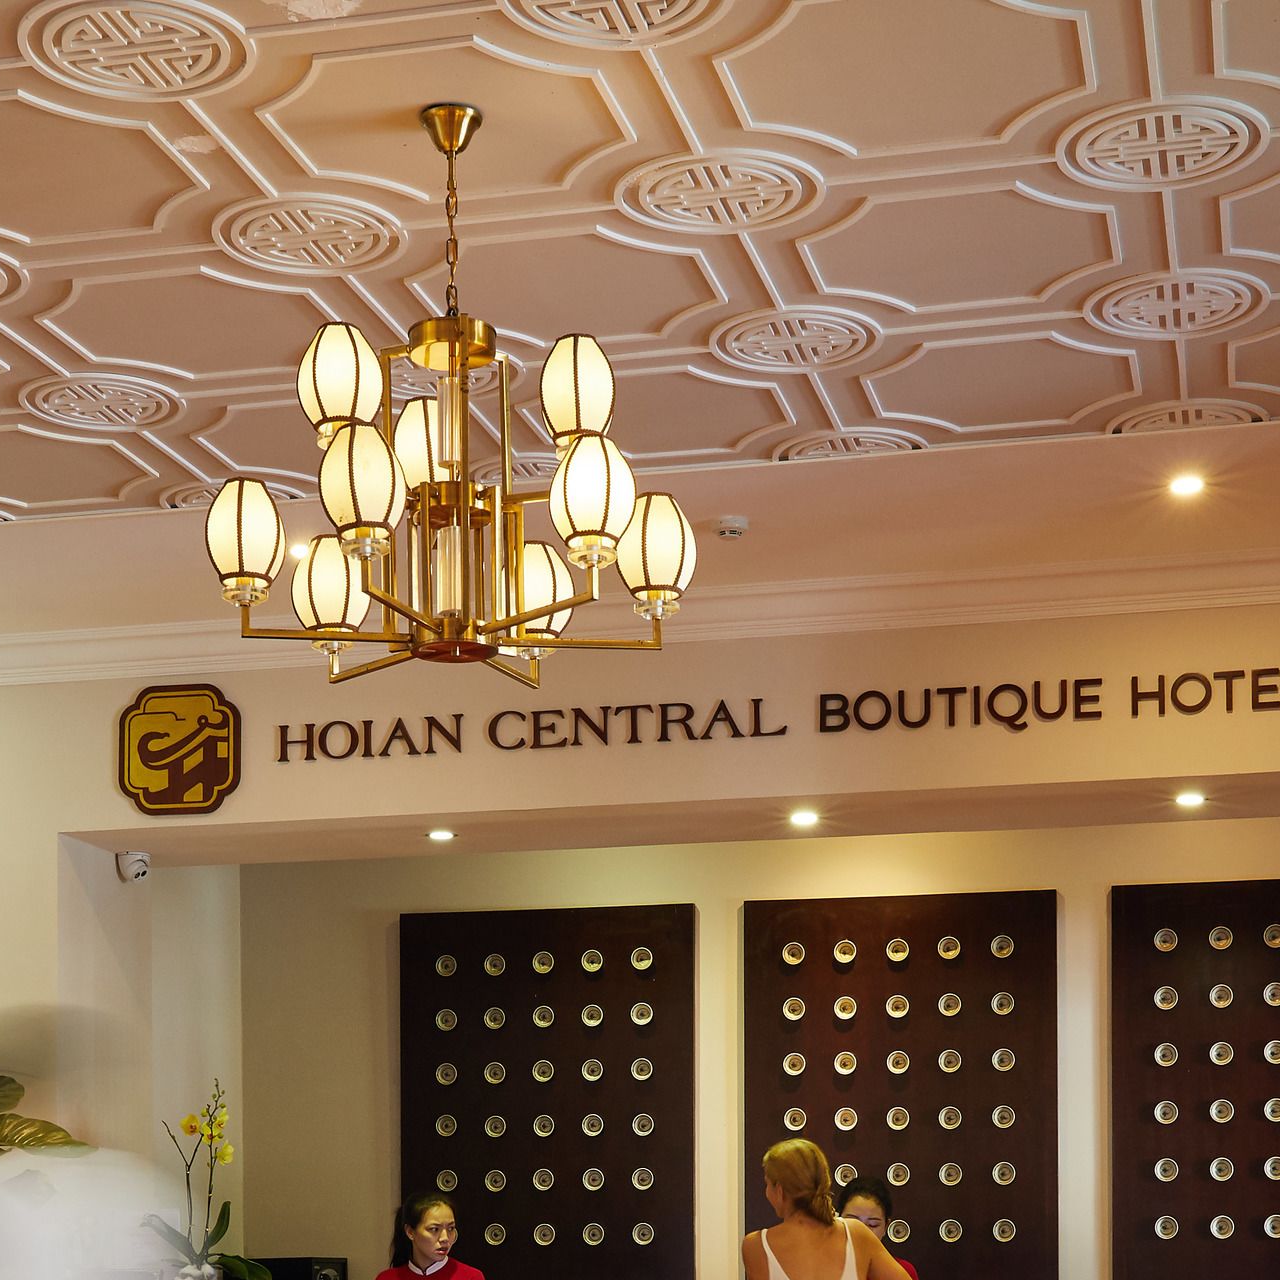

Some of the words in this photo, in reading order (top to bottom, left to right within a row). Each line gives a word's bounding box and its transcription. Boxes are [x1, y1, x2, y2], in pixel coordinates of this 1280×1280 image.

[276, 712, 463, 764] HOIAN
[486, 697, 787, 752] CENTRAL
[818, 678, 1104, 732] BOUTIQUE
